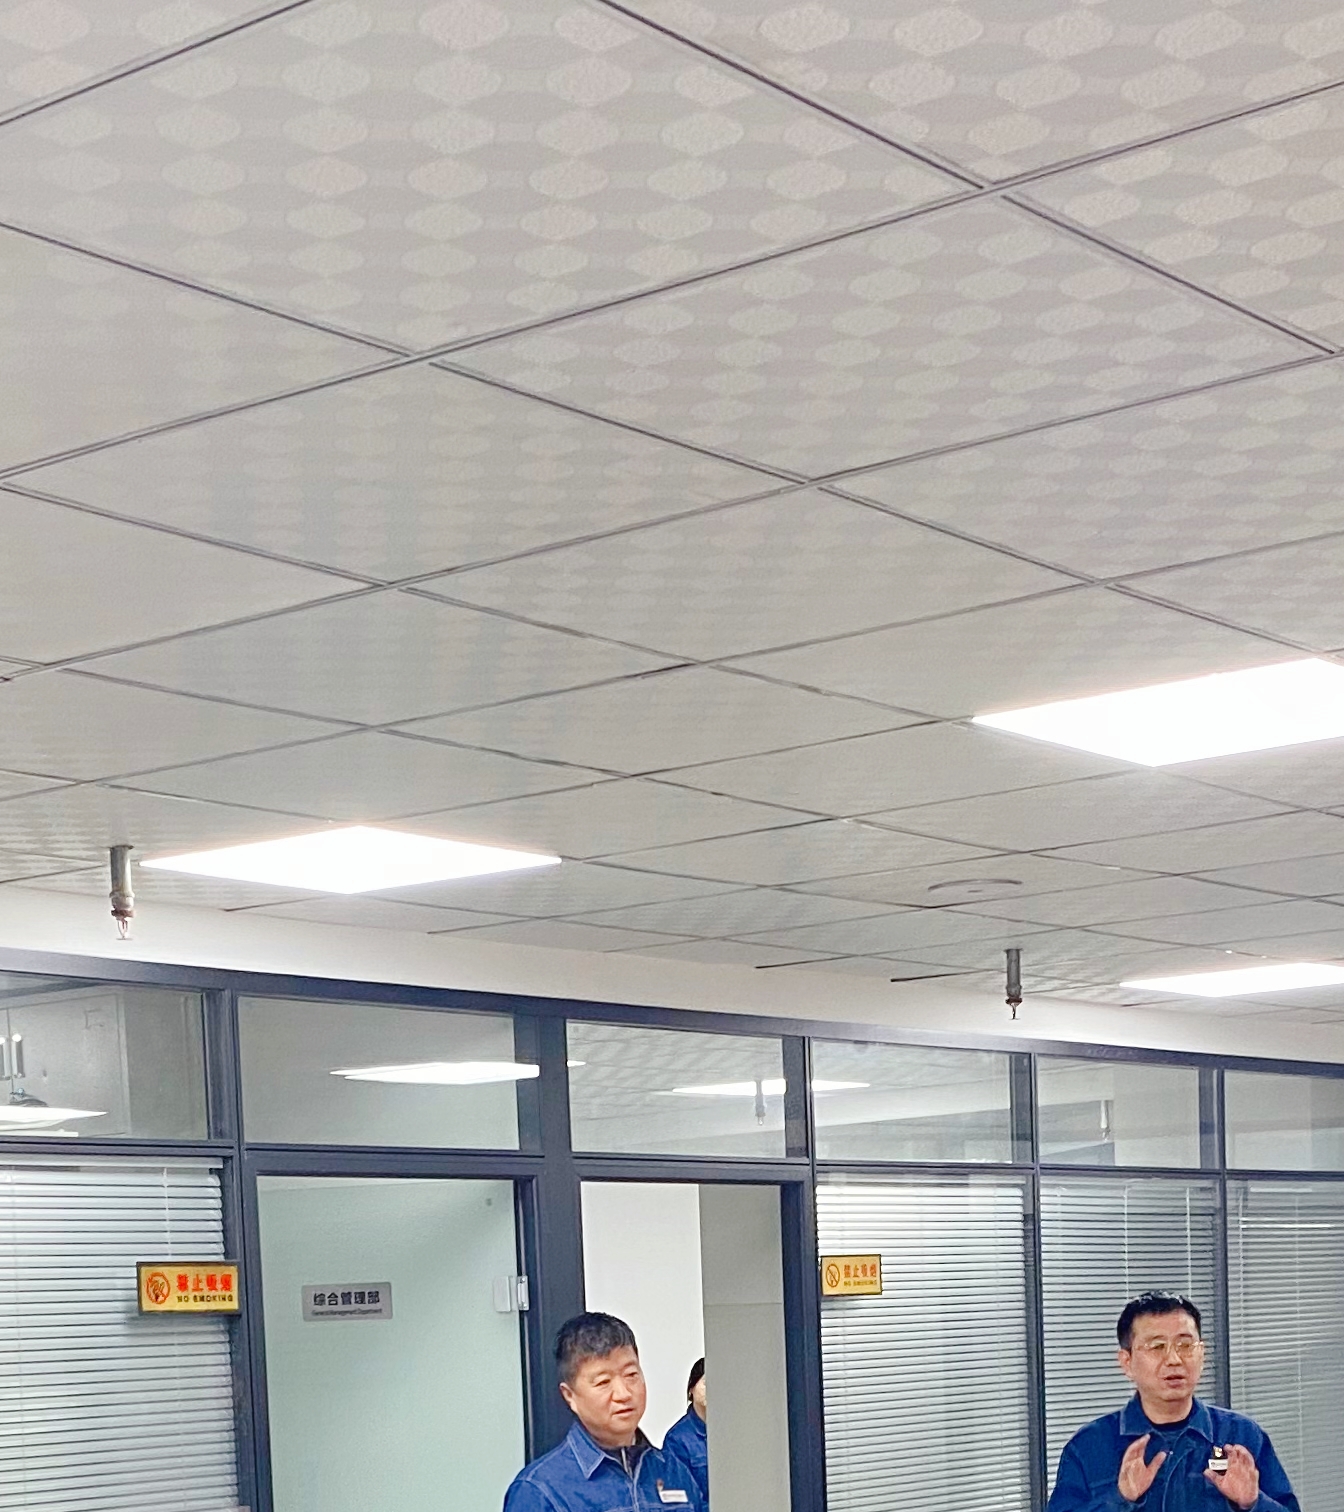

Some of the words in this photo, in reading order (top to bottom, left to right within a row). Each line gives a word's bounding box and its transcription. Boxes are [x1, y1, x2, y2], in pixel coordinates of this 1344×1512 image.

[193, 1293, 233, 1303] SMOKING
[313, 1290, 381, 1306] 综合管理部
